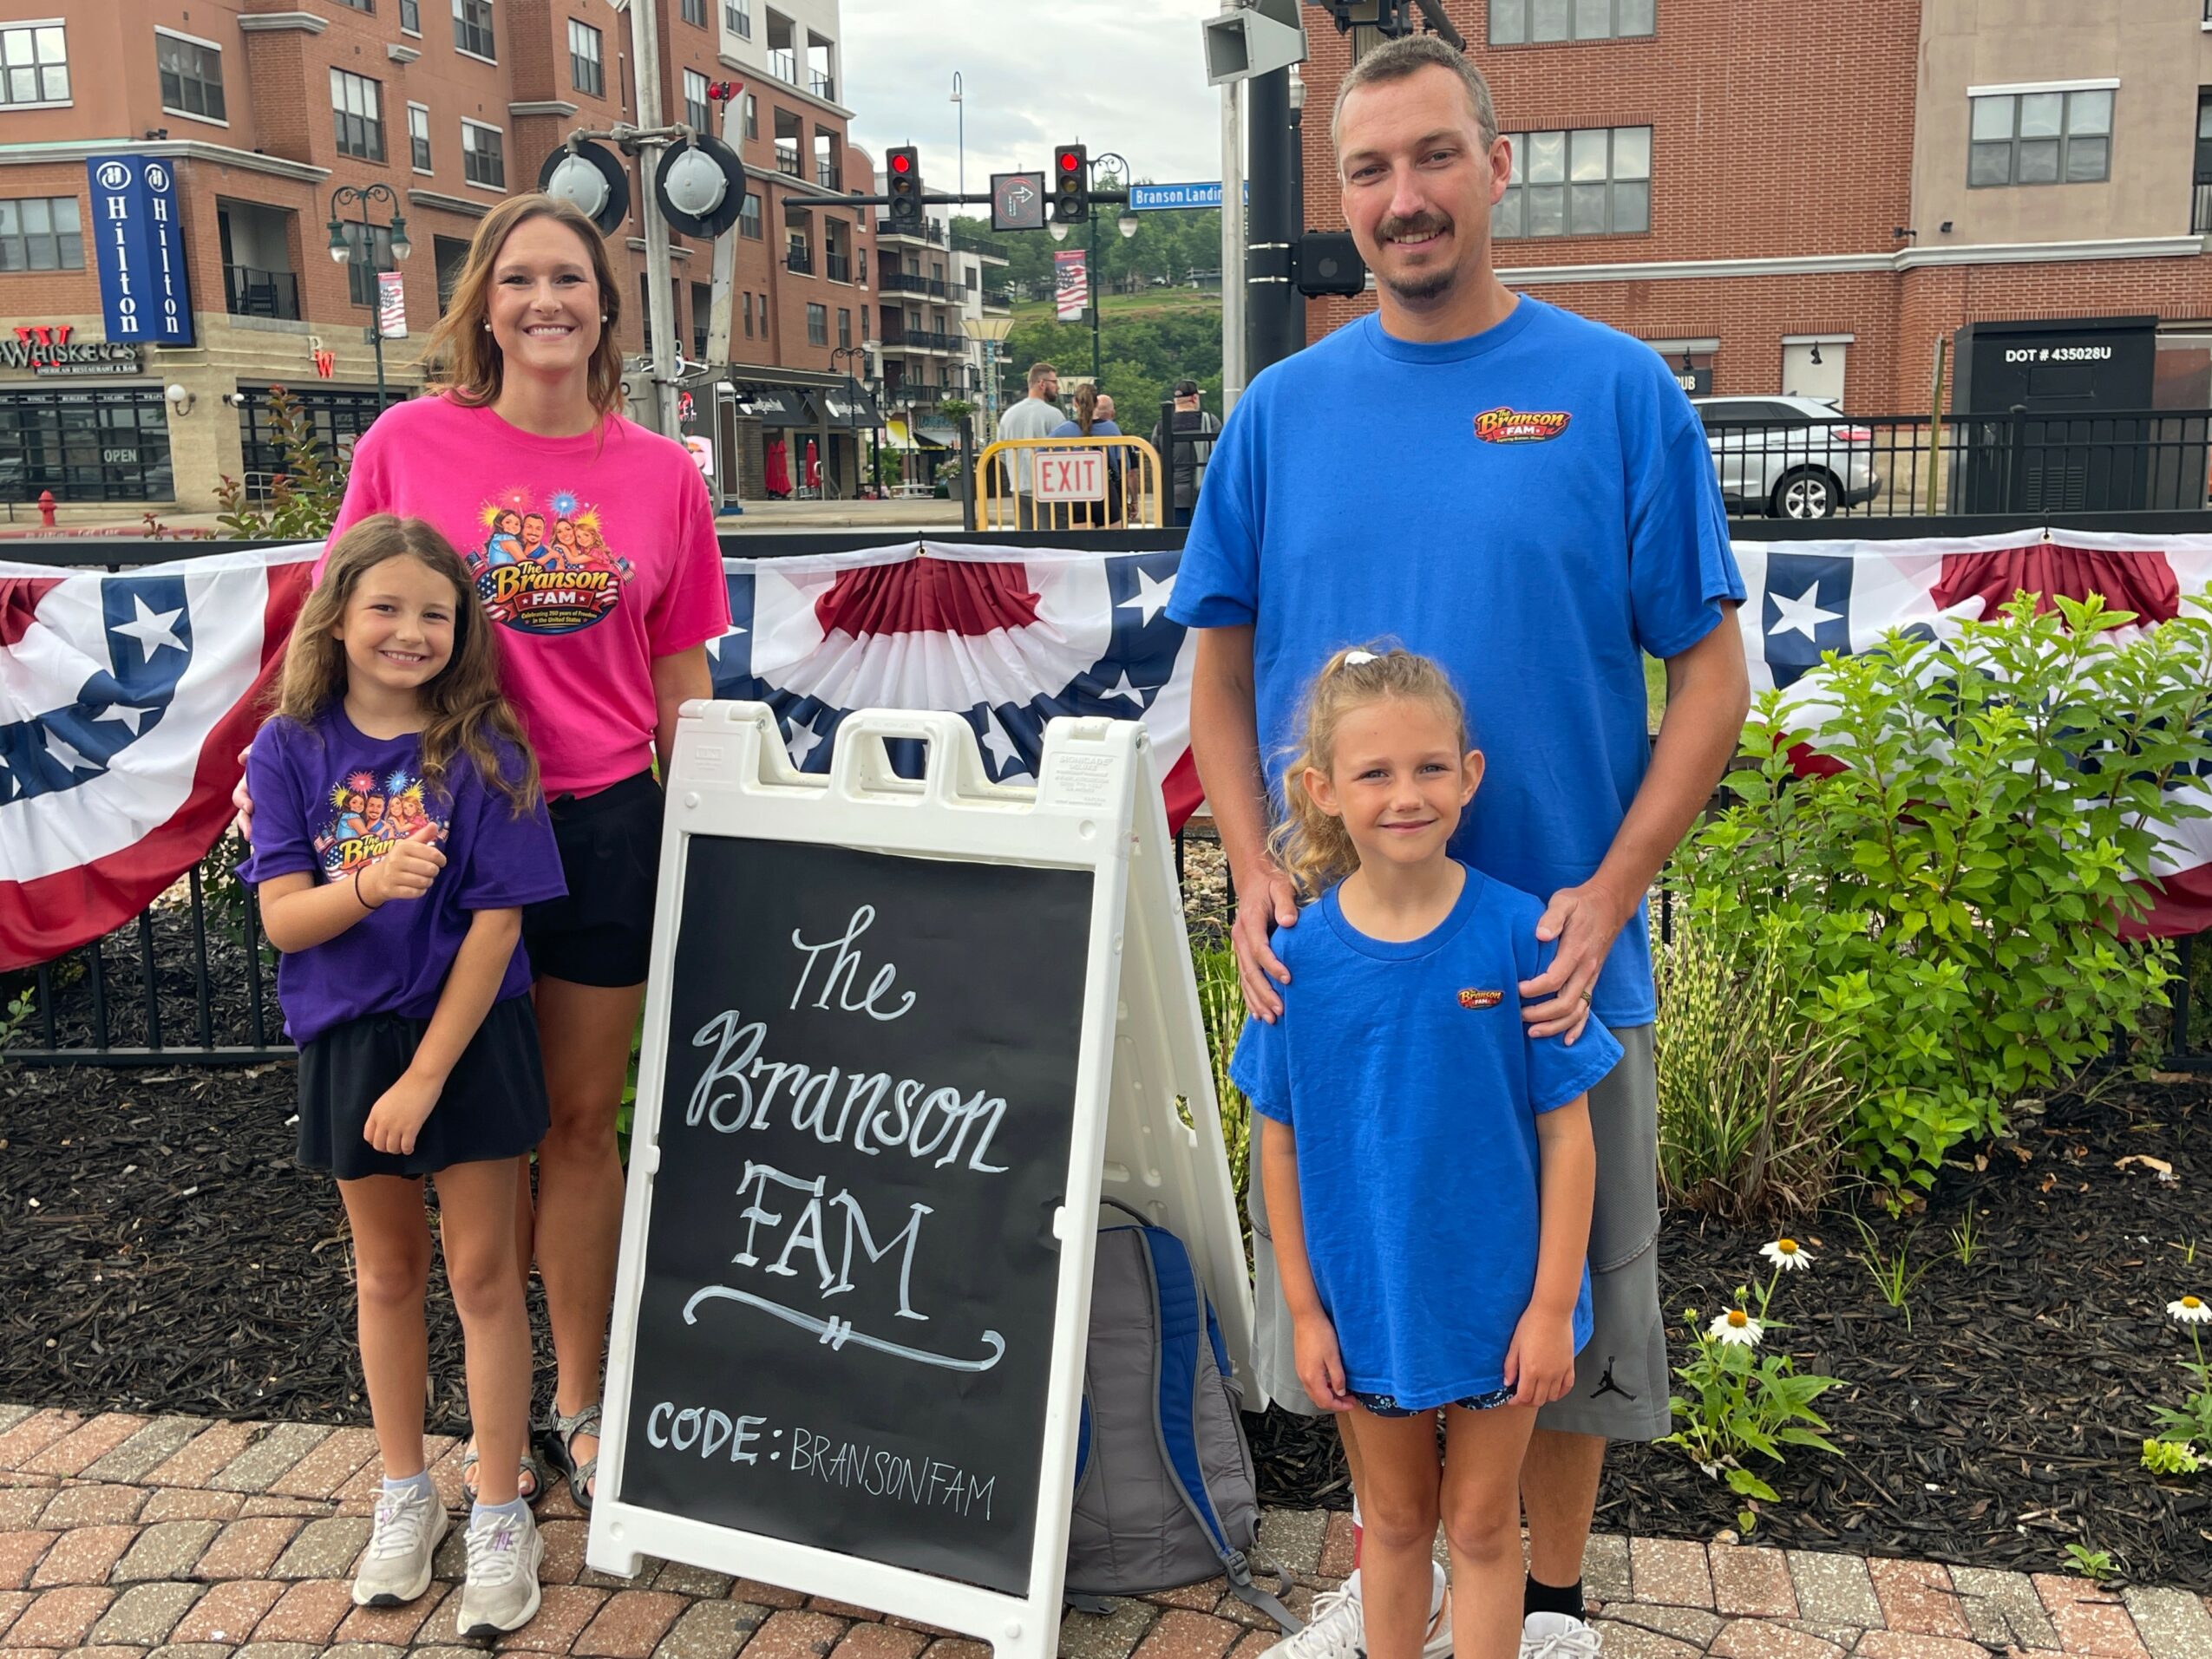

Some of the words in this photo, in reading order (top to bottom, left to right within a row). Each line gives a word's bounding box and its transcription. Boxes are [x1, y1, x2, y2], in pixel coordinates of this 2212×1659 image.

[1136, 190, 1183, 204] Branson
[1186, 187, 1222, 202] Landin
[106, 196, 139, 333] Hilton
[152, 198, 179, 333] Hilton
[2006, 349, 2037, 362] DOT
[2039, 349, 2049, 361] #
[2051, 347, 2111, 361] 435028U
[1477, 413, 1565, 434] Branson
[1507, 426, 1535, 435] FAM
[103, 449, 137, 462] OPEN
[1043, 460, 1095, 493] EXIT
[517, 561, 543, 574] The
[491, 565, 610, 604] Branson
[532, 591, 576, 605] FAM
[521, 611, 548, 619] Celebrating
[360, 834, 380, 846] The
[339, 839, 395, 870] Bran
[791, 904, 917, 1021] The
[1459, 990, 1502, 1003] Branson
[686, 1009, 1010, 1173] Branson
[731, 1159, 935, 1321] FAM
[646, 1401, 782, 1466] CODE:
[790, 1427, 996, 1521] BRANSONFAM
